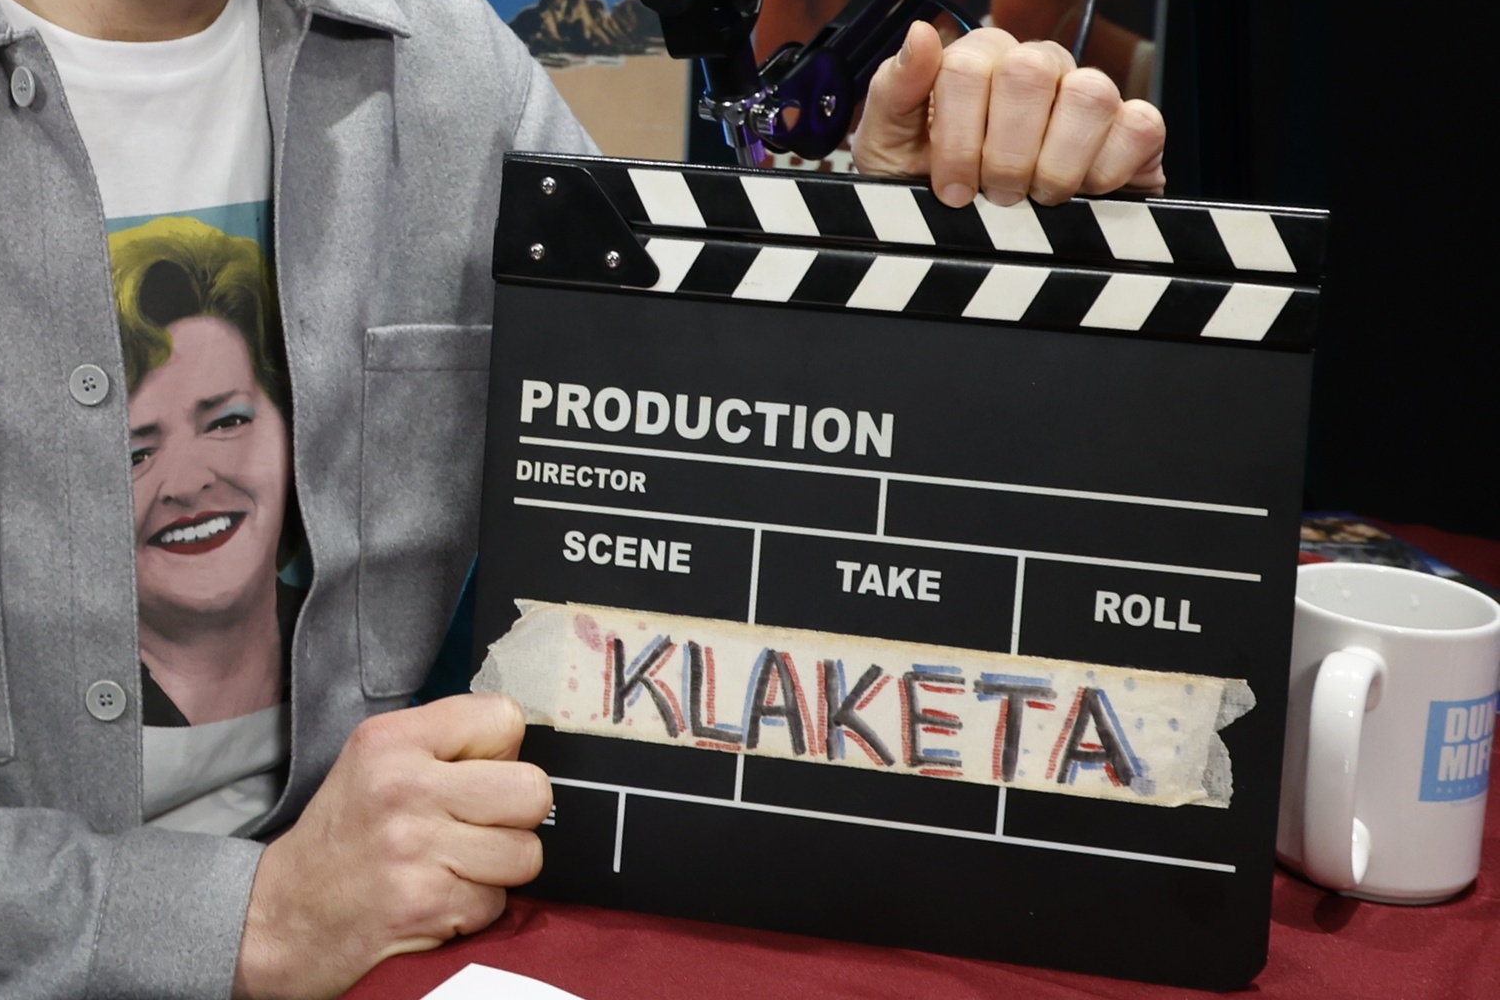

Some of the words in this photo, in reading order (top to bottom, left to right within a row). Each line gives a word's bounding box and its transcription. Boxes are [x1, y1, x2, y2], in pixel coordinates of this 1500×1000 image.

[520, 379, 895, 458] PRODUCTION
[515, 459, 647, 493] DIRECTOR
[562, 530, 692, 575] SCENE
[836, 560, 942, 602] TAKE
[1094, 590, 1202, 633] ROLL
[603, 634, 1150, 790] KLAKETA
